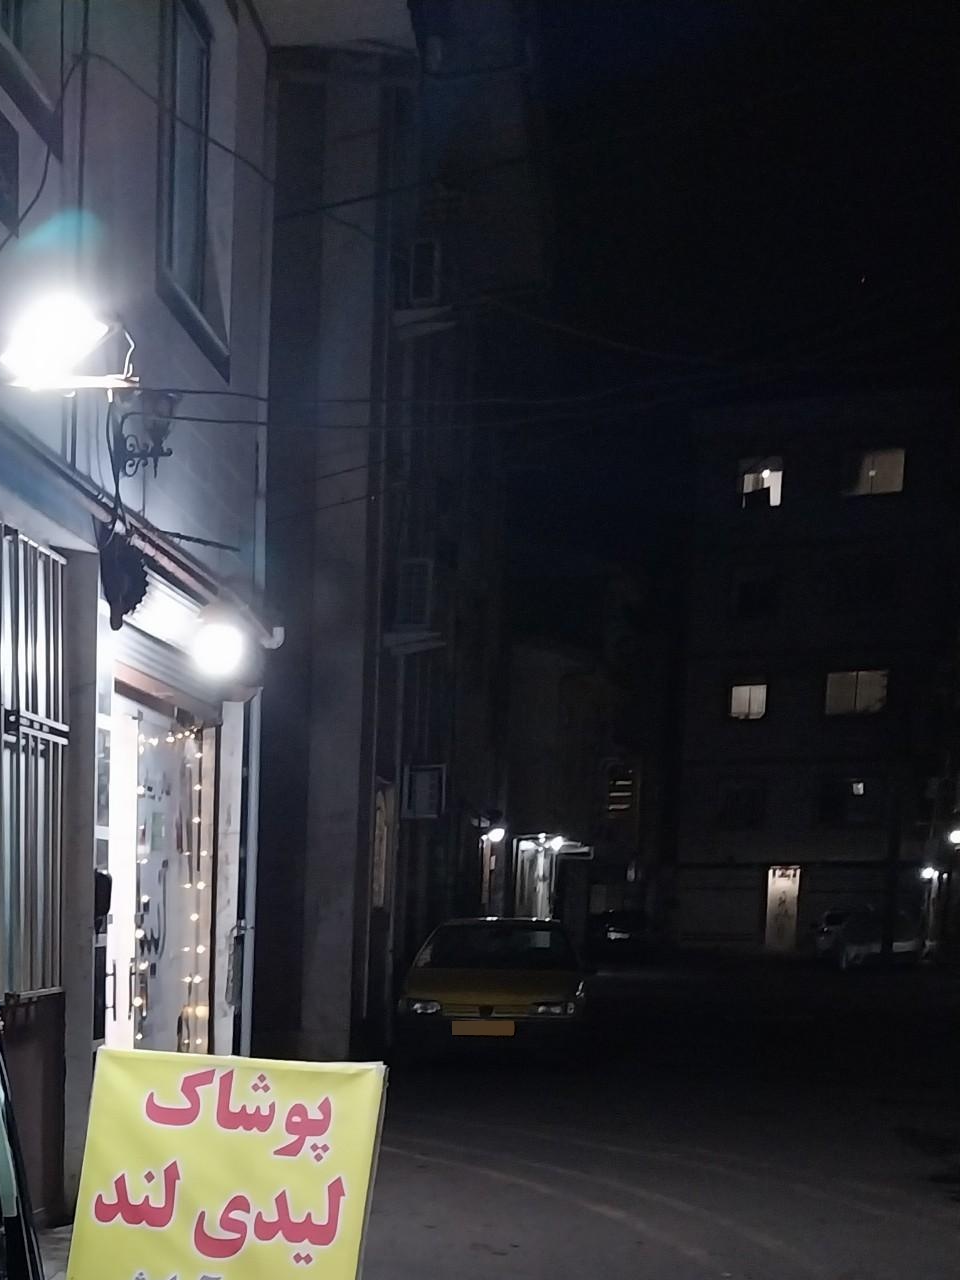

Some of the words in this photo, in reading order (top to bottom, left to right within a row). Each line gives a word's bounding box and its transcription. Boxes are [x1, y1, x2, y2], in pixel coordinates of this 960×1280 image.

[145, 1069, 331, 1162] پوشاک
[94, 1161, 181, 1228] لند
[193, 1177, 346, 1264] لیدی
